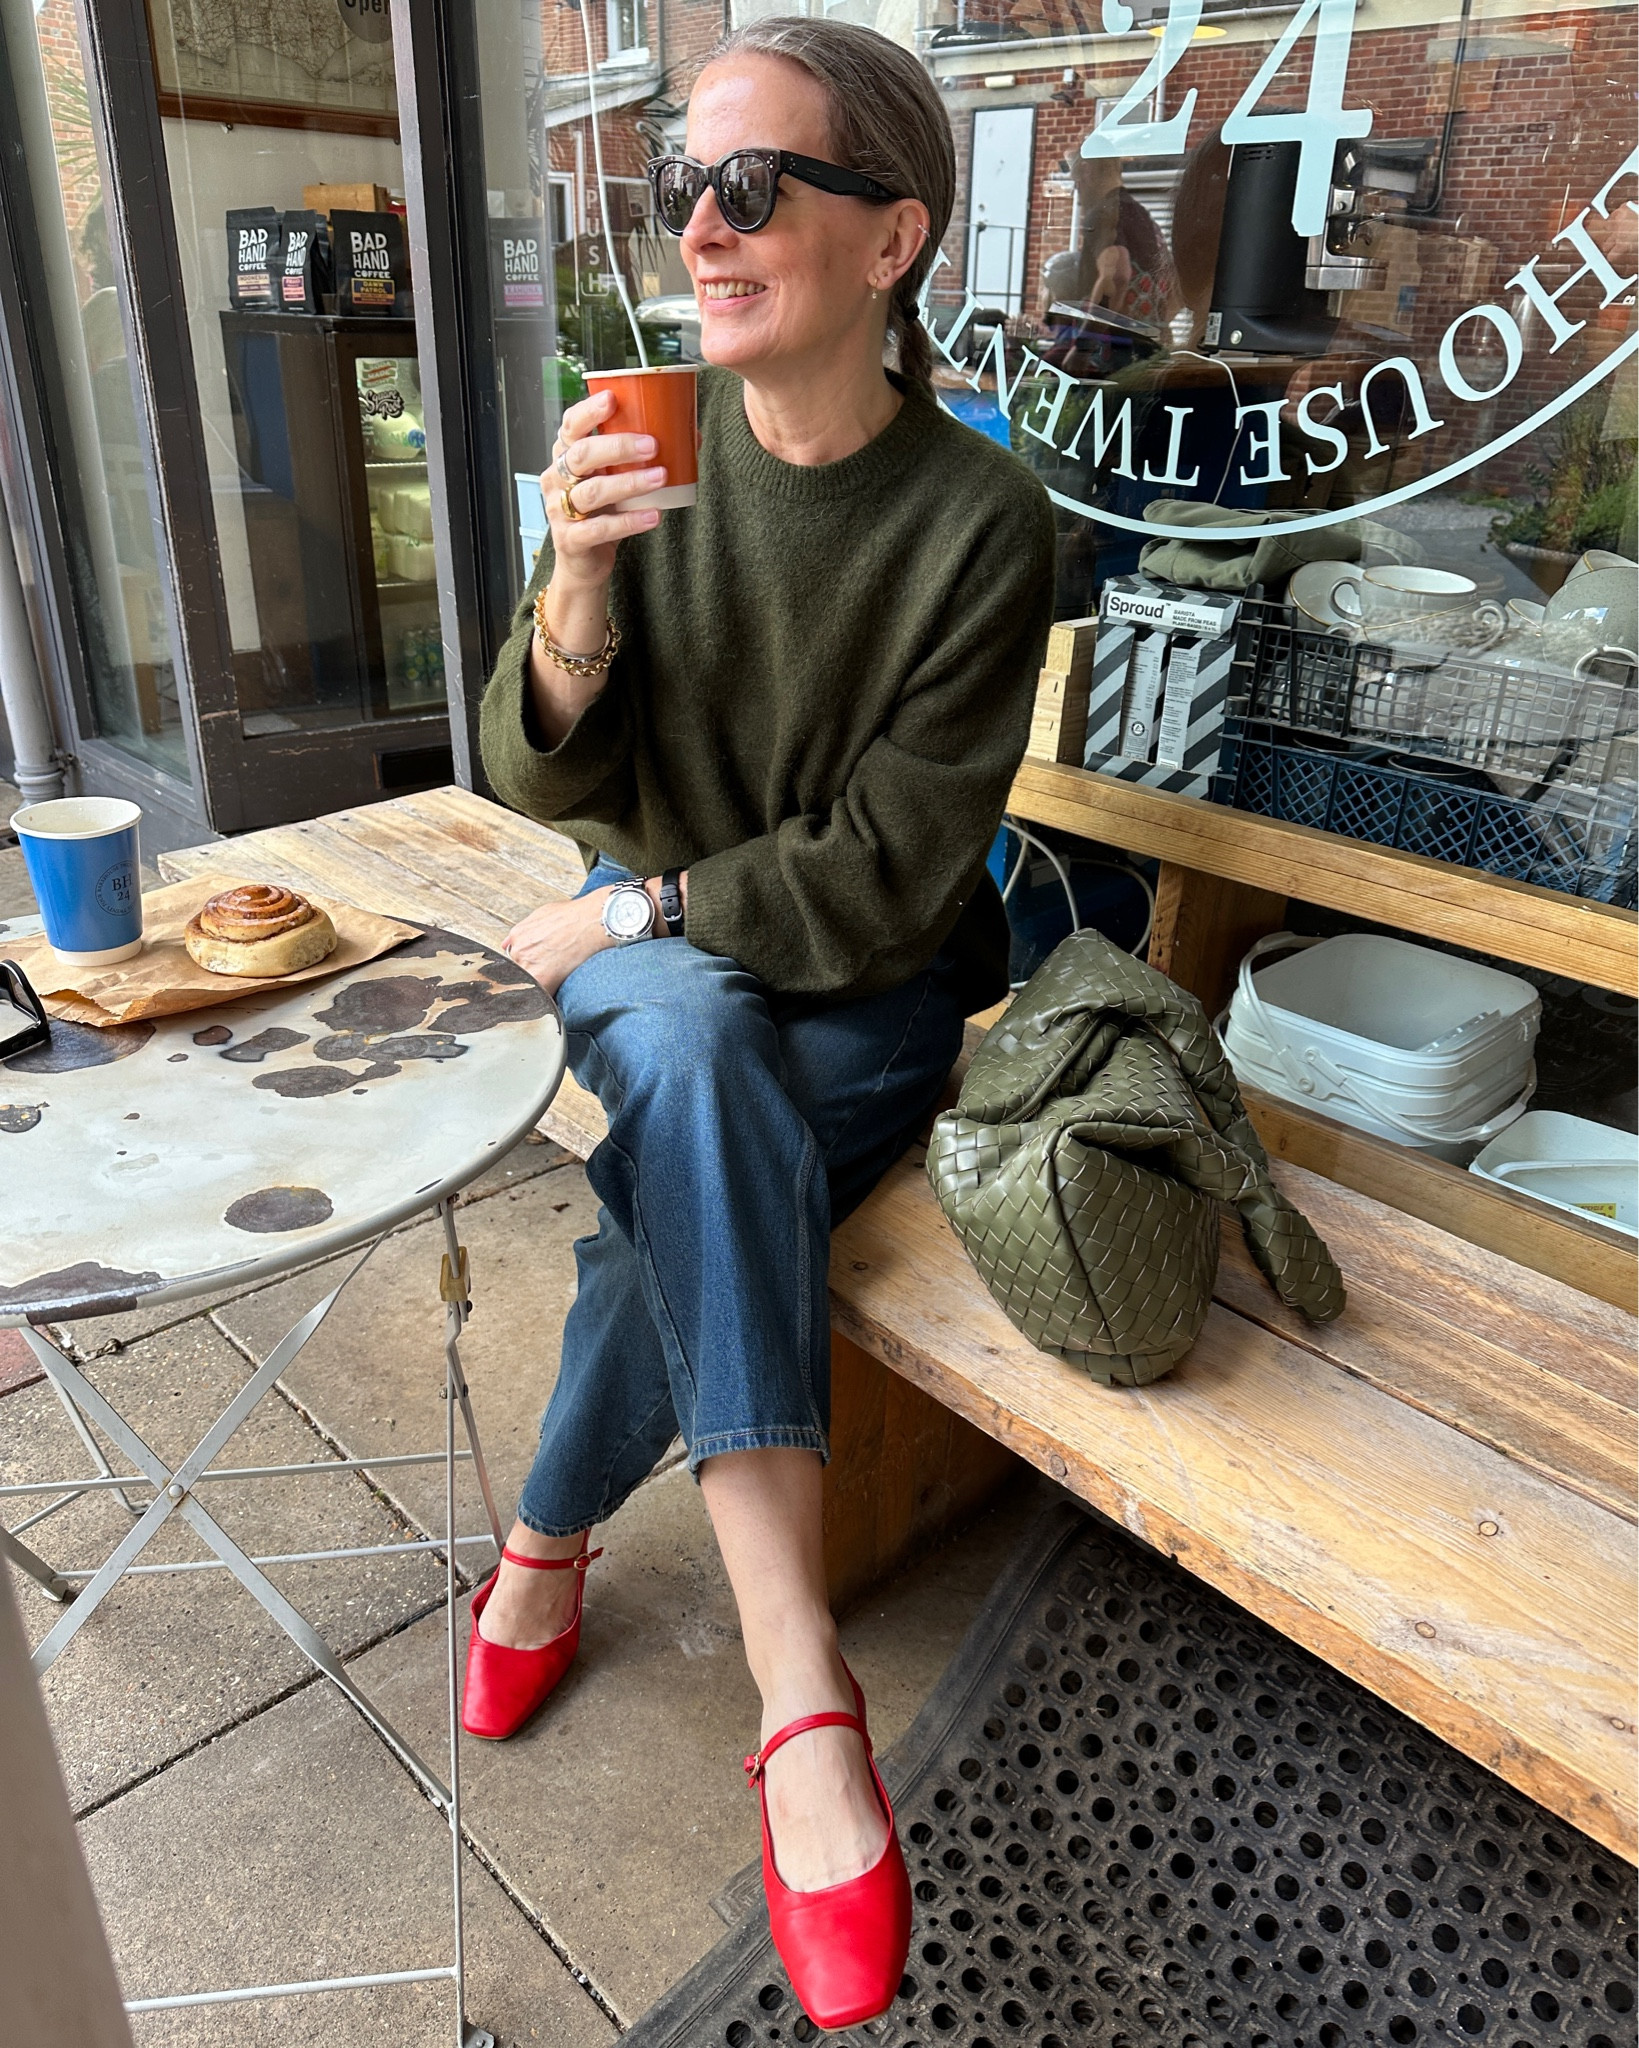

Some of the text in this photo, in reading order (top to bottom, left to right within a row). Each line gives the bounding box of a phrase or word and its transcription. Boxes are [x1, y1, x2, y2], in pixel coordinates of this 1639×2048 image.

[1081, 0, 1373, 236] 24
[239, 228, 268, 249] BAD
[288, 231, 308, 252] BAD
[350, 231, 387, 253] BAD
[238, 242, 267, 263] HAND
[285, 246, 306, 267] HAND
[503, 239, 538, 259] BAD
[238, 262, 267, 271] COFFEE
[352, 249, 390, 270] HAND
[504, 253, 539, 273] HAND
[284, 267, 304, 275] COFFEE
[354, 269, 391, 279] COFFEE
[505, 273, 540, 281] COFFEE
[1109, 596, 1165, 619] Sproud
[1173, 609, 1195, 617] BARISTA
[1172, 615, 1217, 627] MADE FROM PEAS
[112, 873, 132, 891] BH
[117, 890, 130, 901] 24
